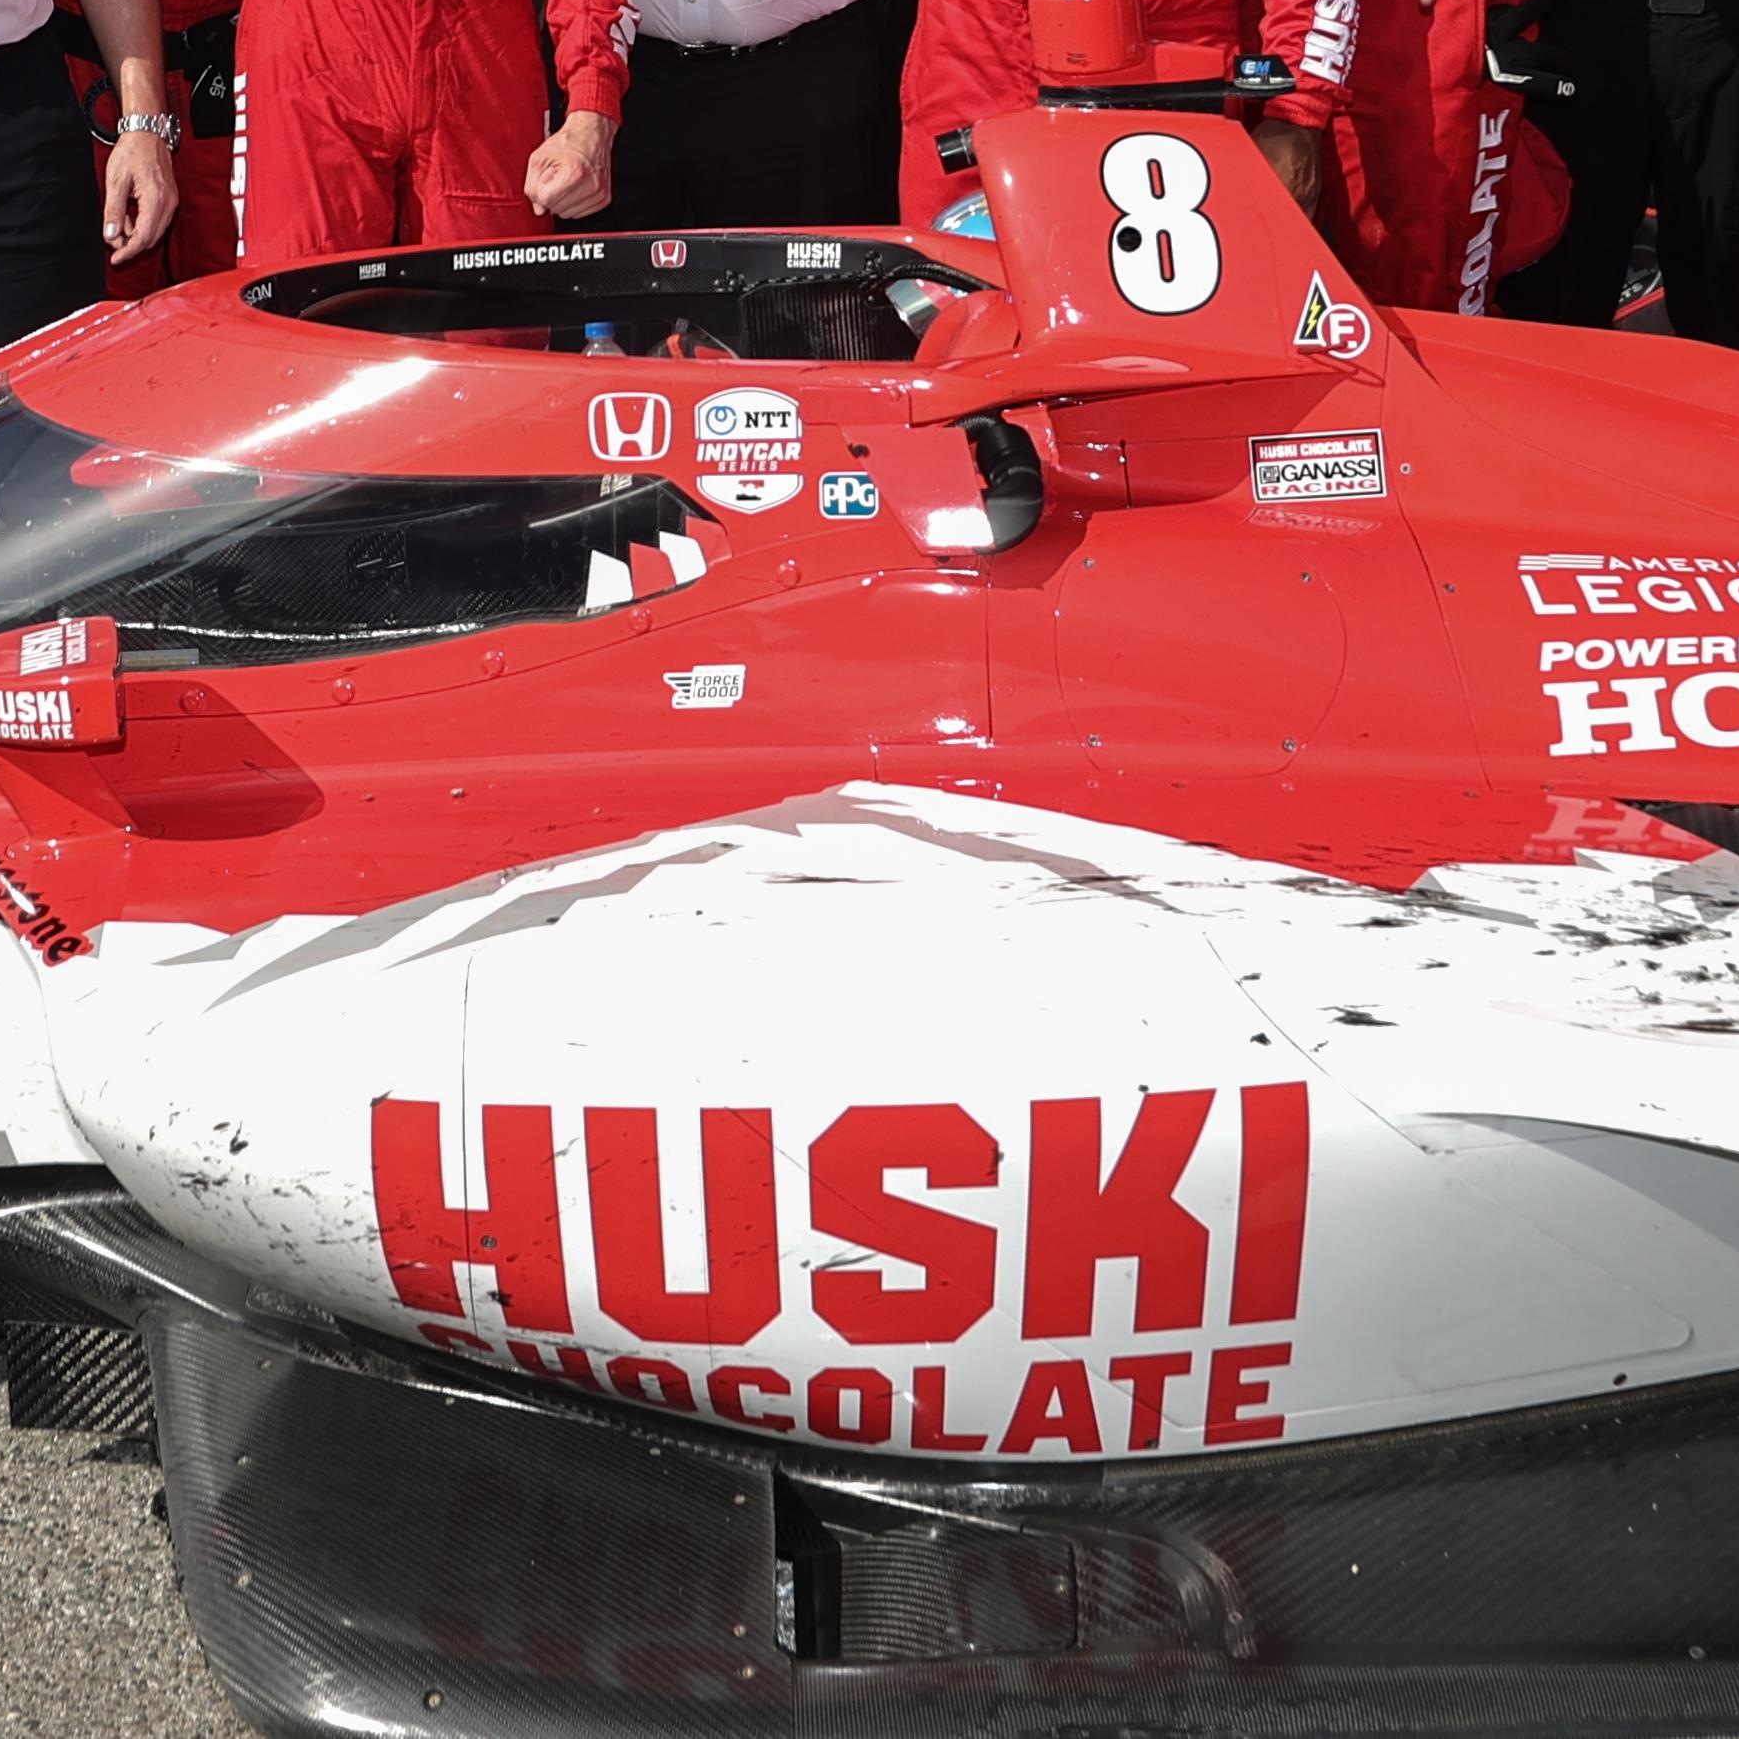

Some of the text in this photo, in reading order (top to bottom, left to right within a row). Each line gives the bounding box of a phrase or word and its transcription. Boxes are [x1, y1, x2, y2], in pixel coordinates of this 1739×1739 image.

[1099, 131, 1224, 316] 8
[453, 242, 605, 271] HUSKI CHOCOLATE
[786, 241, 842, 263] HUSKI
[785, 256, 842, 270] CHOCOLATE
[743, 410, 792, 431] NTT
[695, 440, 801, 463] INDYCAR
[1259, 439, 1373, 459] HUSKI CHOCOLATE
[717, 461, 779, 474] SERIES
[1259, 458, 1376, 485] CHIP GANASSI
[822, 474, 878, 515] PPG
[1261, 479, 1378, 496] RACING
[694, 674, 740, 686] FORCE
[697, 685, 739, 698] GOOD
[370, 1079, 1309, 1346] HUSKI
